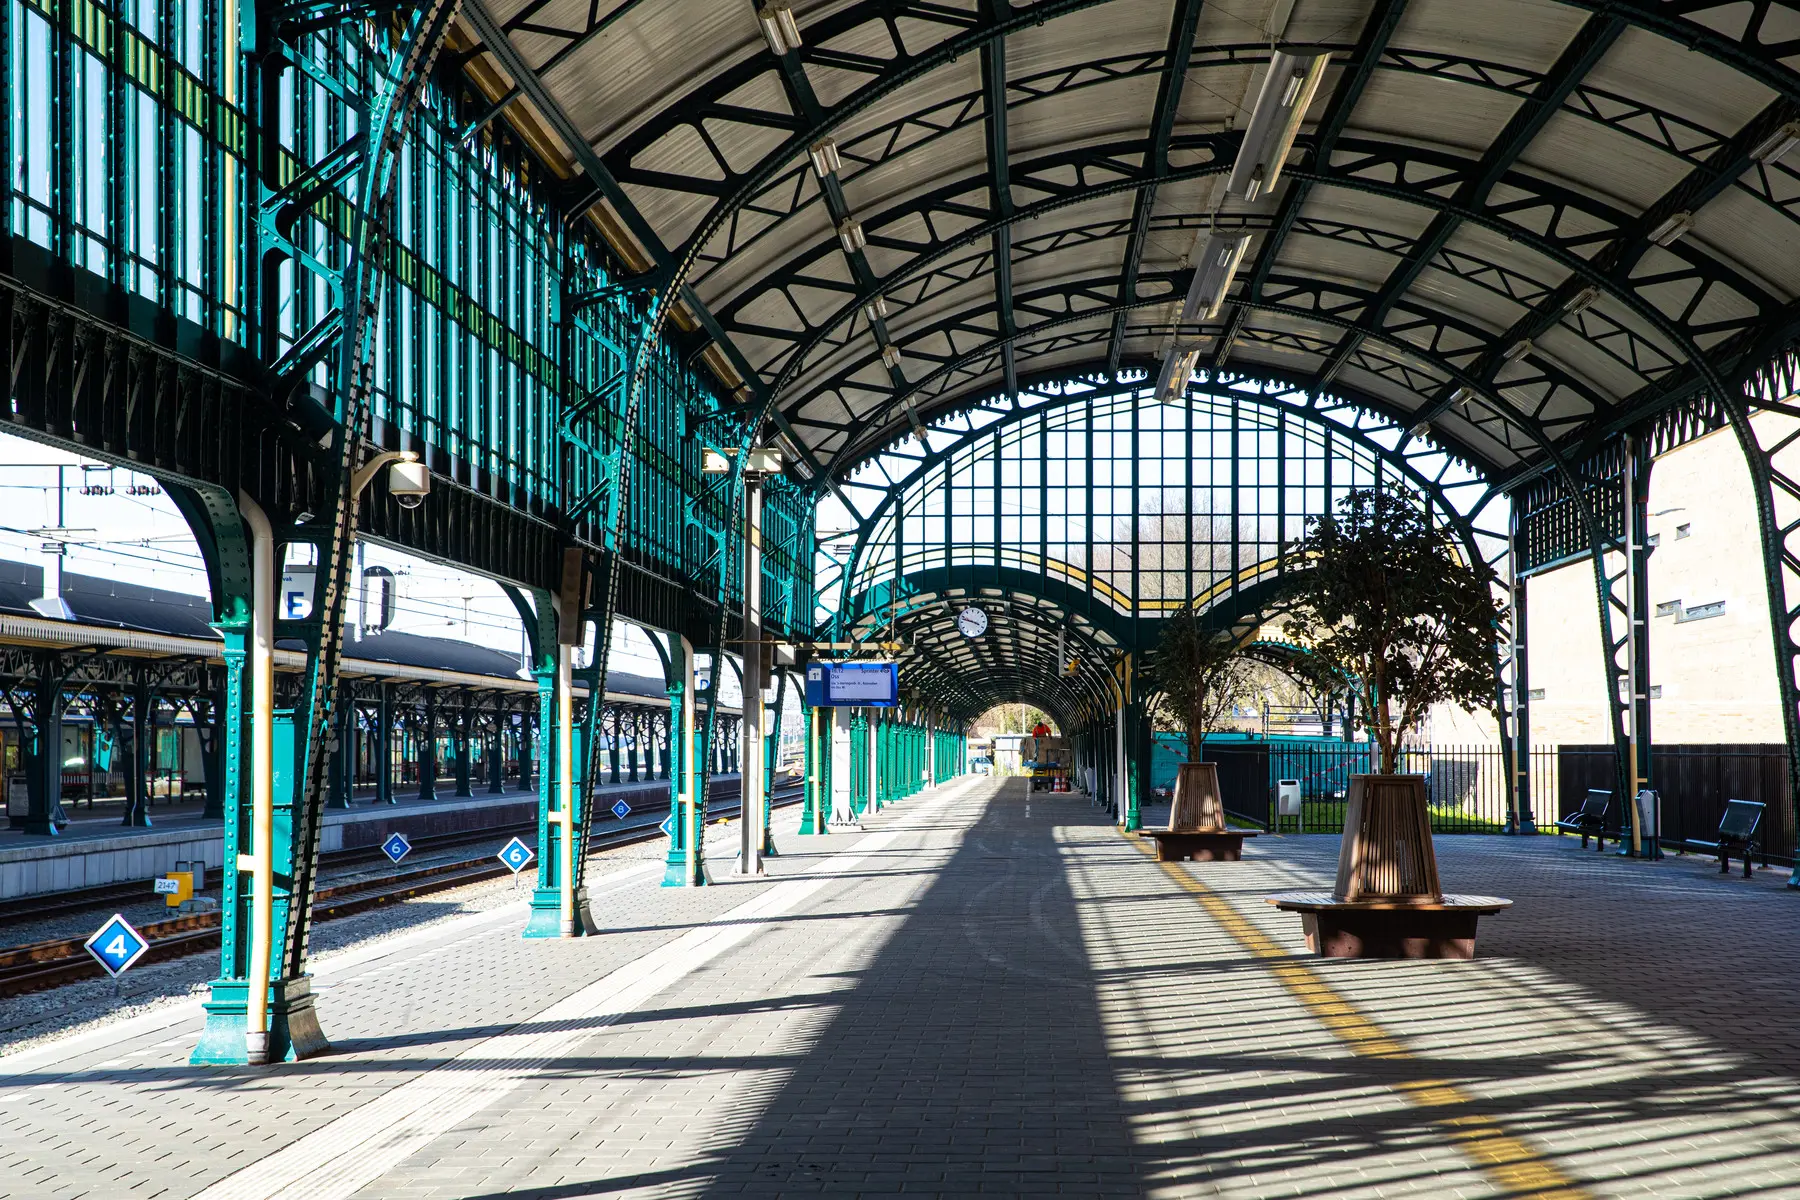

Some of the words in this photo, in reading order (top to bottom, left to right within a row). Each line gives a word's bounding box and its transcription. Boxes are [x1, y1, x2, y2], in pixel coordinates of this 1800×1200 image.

[287, 591, 305, 619] E
[700, 679, 711, 690] D
[617, 805, 625, 814] 8
[391, 842, 401, 854] 6
[509, 848, 522, 862] 6
[157, 881, 176, 890] 2147
[104, 934, 128, 959] 4
